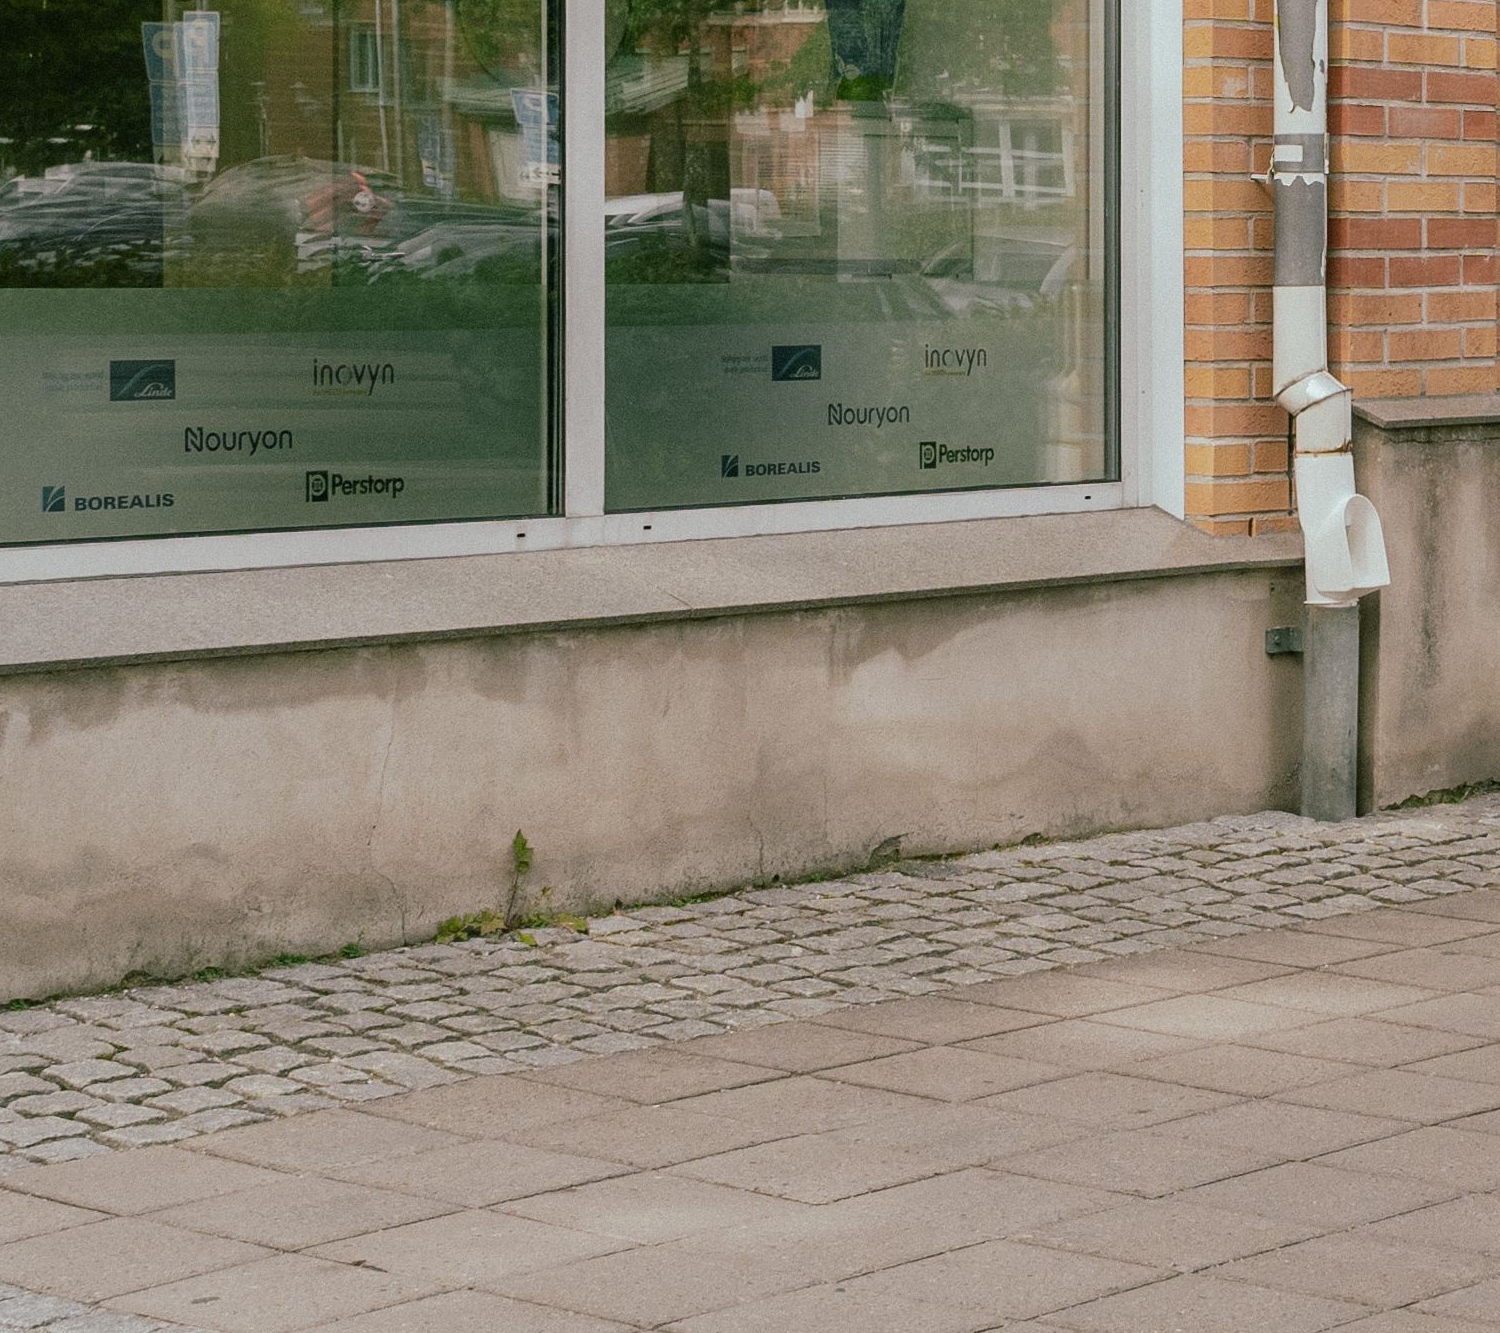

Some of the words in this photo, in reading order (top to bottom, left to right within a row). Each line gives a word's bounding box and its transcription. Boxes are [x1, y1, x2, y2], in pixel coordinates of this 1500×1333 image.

[134, 382, 174, 398] Linde
[828, 402, 910, 429] Nouryon
[184, 426, 293, 457] Nouryon
[938, 443, 995, 467] Perstorp
[745, 460, 821, 477] BOREALIS
[331, 473, 405, 499] Perstorp
[74, 493, 175, 512] BOREALIS
